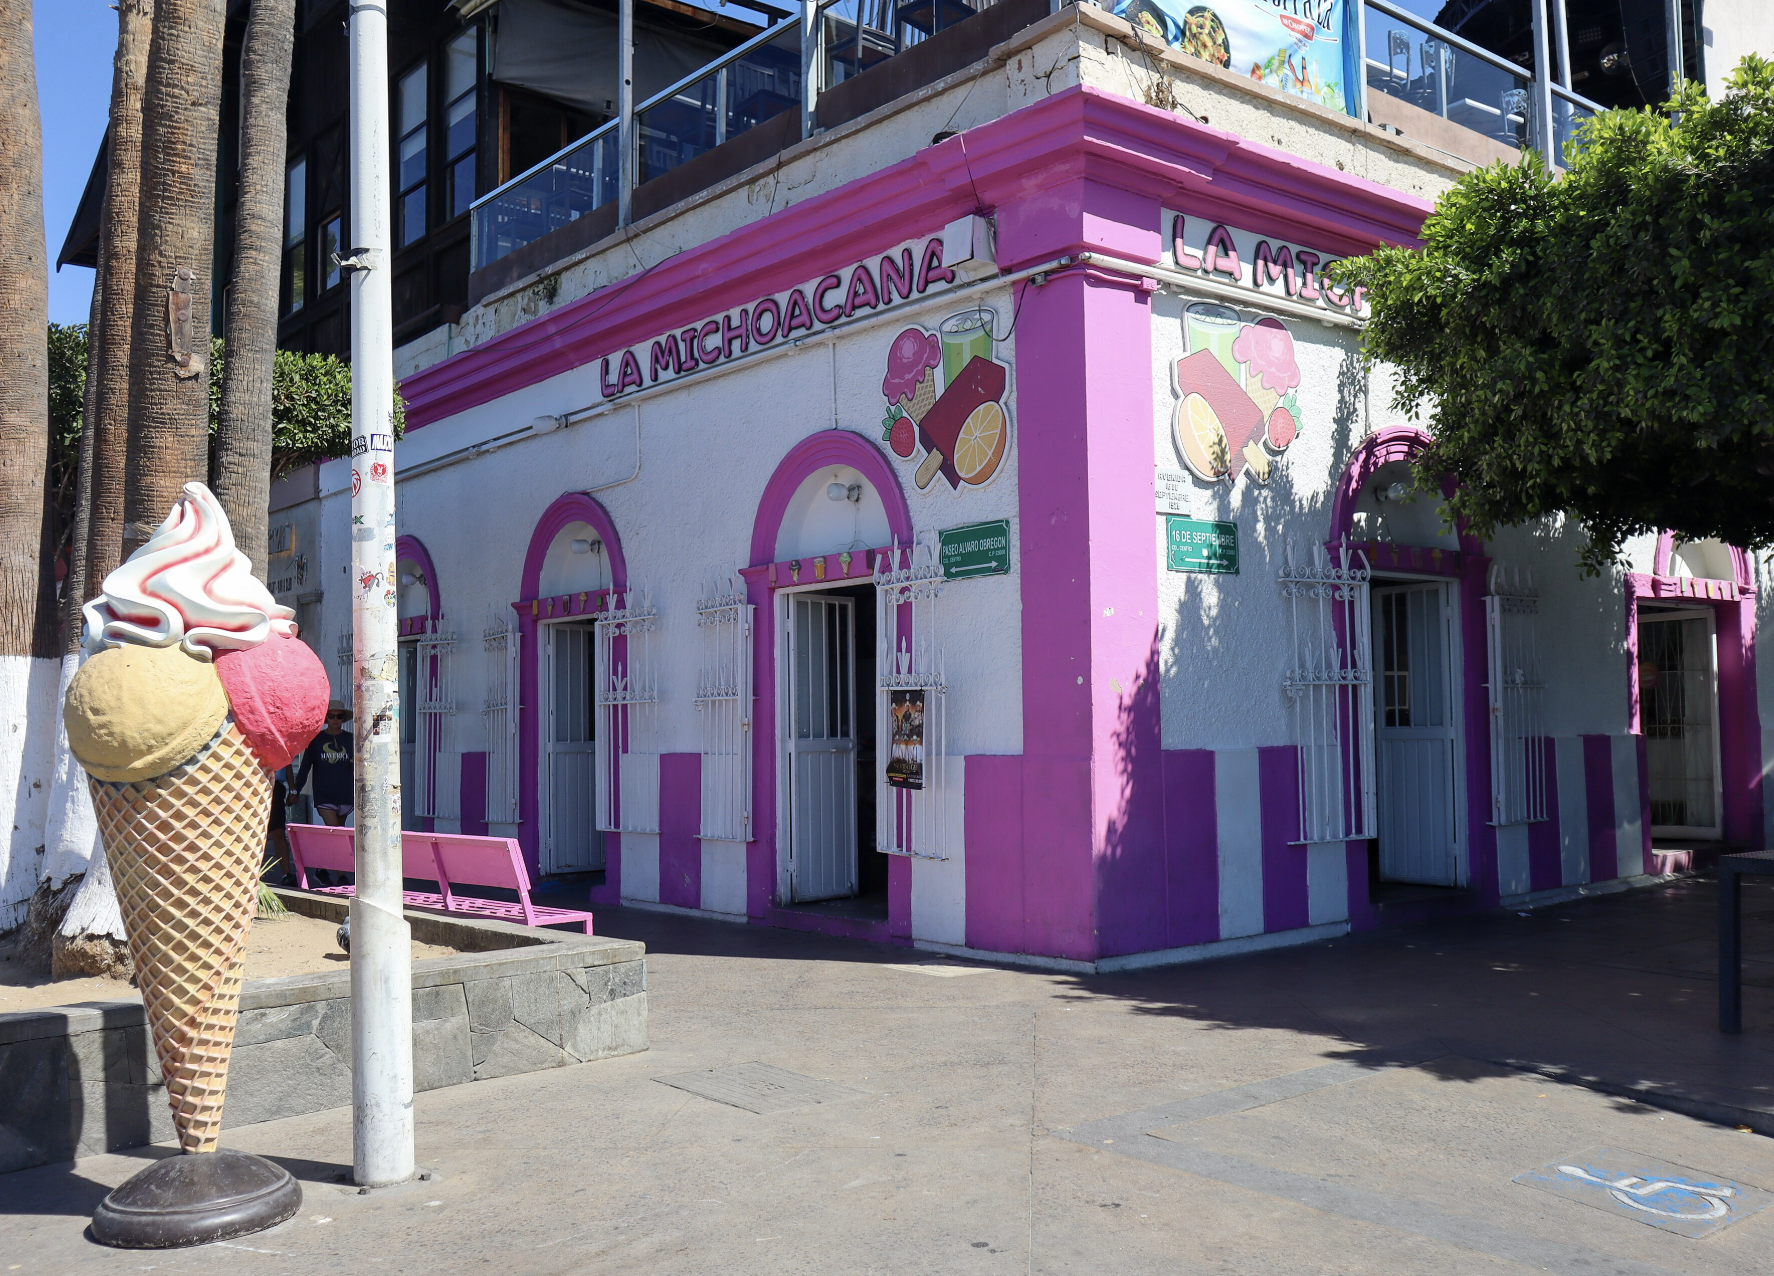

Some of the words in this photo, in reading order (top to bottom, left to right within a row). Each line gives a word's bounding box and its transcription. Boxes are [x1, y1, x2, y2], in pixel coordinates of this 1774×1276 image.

[1173, 214, 1242, 282] LA
[601, 349, 643, 398] LA
[650, 237, 956, 383] MICHOACANA
[943, 543, 958, 556] PASEO
[959, 540, 978, 554] ALVARO
[979, 536, 1005, 550] OBREGON
[1172, 530, 1180, 542] 16
[1181, 531, 1192, 543] DE
[1193, 532, 1234, 546] SEPTIEMBRE
